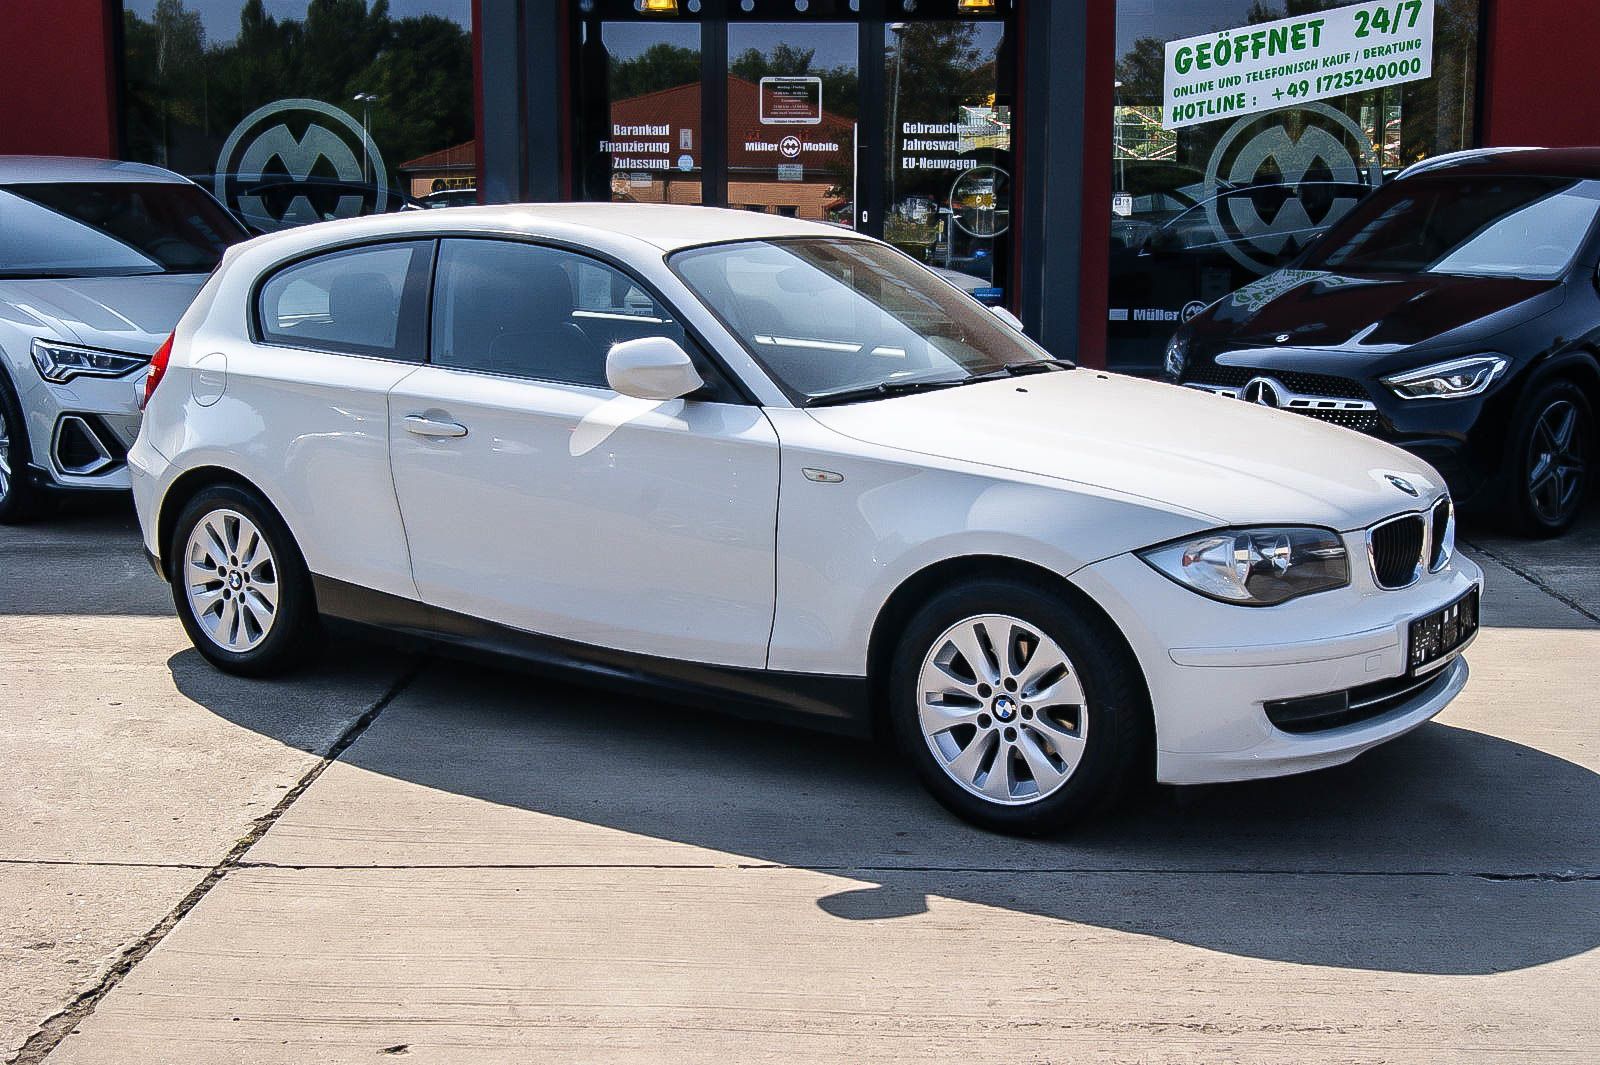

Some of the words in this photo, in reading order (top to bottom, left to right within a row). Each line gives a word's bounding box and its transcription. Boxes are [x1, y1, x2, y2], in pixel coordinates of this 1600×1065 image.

[1174, 19, 1325, 75] GEÖFFNET
[1354, 0, 1423, 38] 24/7
[1173, 80, 1215, 99] ONLINE
[1218, 75, 1242, 89] UND
[1245, 59, 1319, 84] TELEFONISCH
[1322, 52, 1351, 69] KAUF
[1354, 50, 1360, 64] /
[1362, 38, 1423, 60] BERATUNG
[1171, 92, 1247, 123] HOTLINE
[1271, 80, 1310, 102] +49
[1315, 57, 1422, 94] 1725240000
[613, 123, 670, 136] Barankauf
[599, 140, 670, 155] Finanzierung
[744, 140, 779, 152] Müller
[802, 142, 840, 152] Mobile
[613, 156, 670, 170] Zulassung
[902, 156, 978, 171] EU-Neuwagen
[1132, 307, 1181, 321] Müller
